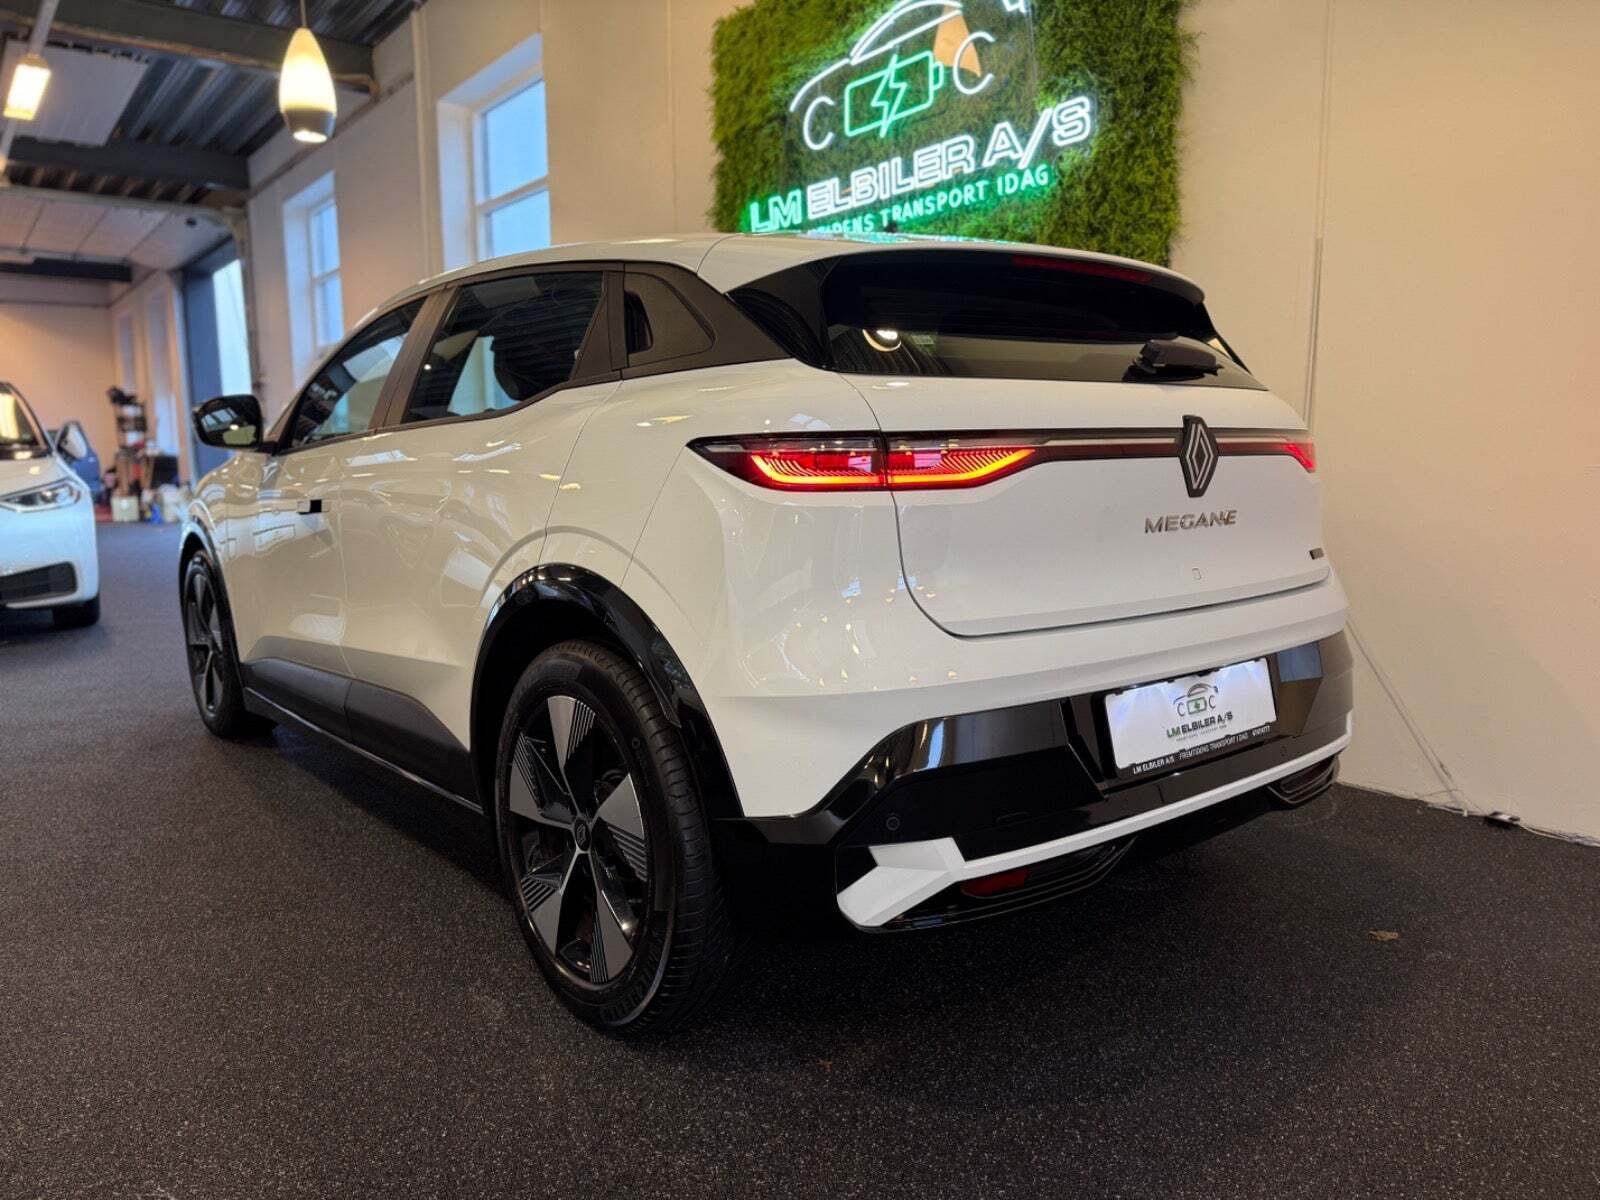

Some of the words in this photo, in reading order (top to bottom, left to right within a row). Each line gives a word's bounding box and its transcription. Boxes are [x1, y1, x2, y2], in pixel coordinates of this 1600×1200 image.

[749, 190, 802, 233] LM
[806, 134, 976, 220] ELBILER
[981, 95, 1093, 169] A/S
[881, 178, 986, 226] TRANSPORT
[996, 163, 1050, 196] IDAG
[1144, 509, 1238, 534] MEGANE
[1166, 726, 1181, 738] LM
[1181, 716, 1216, 733] ELBILER
[1217, 711, 1233, 723] A/S
